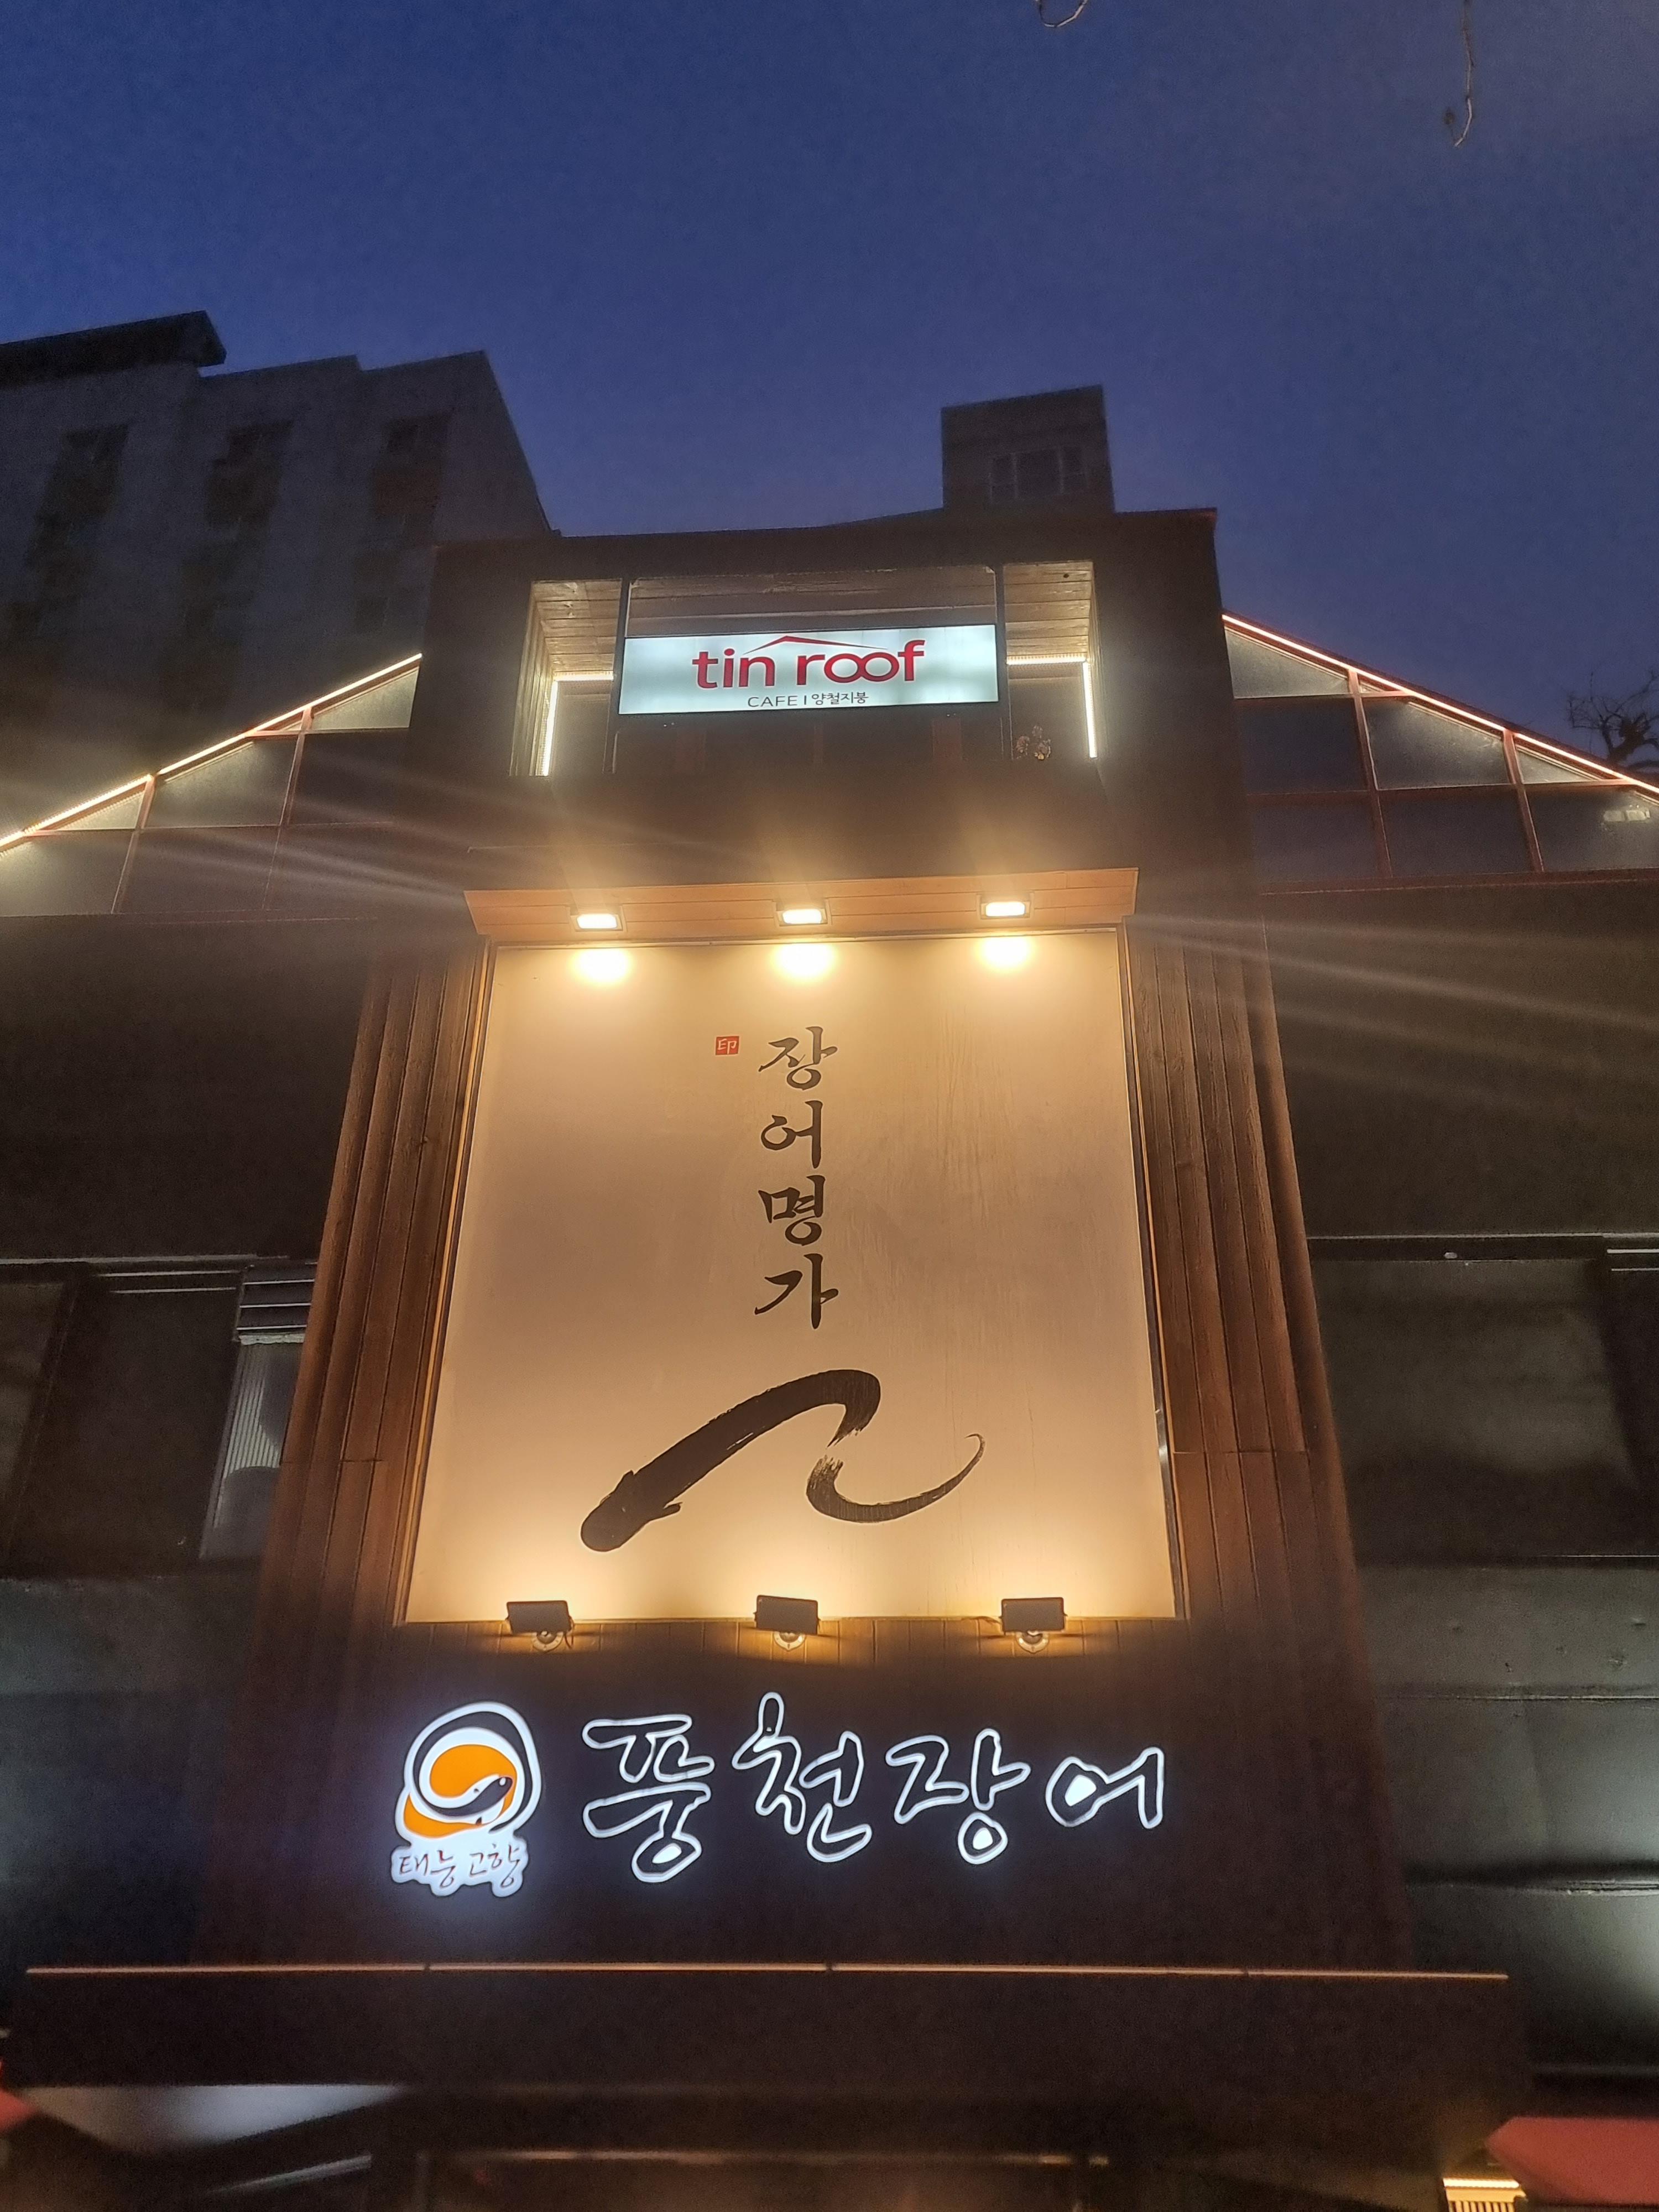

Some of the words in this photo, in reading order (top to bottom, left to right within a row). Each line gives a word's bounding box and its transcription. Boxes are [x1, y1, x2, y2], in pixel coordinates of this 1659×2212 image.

[692, 648, 775, 689] tin
[796, 639, 926, 686] roof
[747, 695, 798, 707] CAFE
[811, 691, 869, 706] 양철지붕
[754, 1025, 839, 1330] 장어명가
[581, 1691, 1165, 1883] 풍천장어
[399, 1849, 456, 1888] 태능
[469, 1843, 521, 1888] 고향
